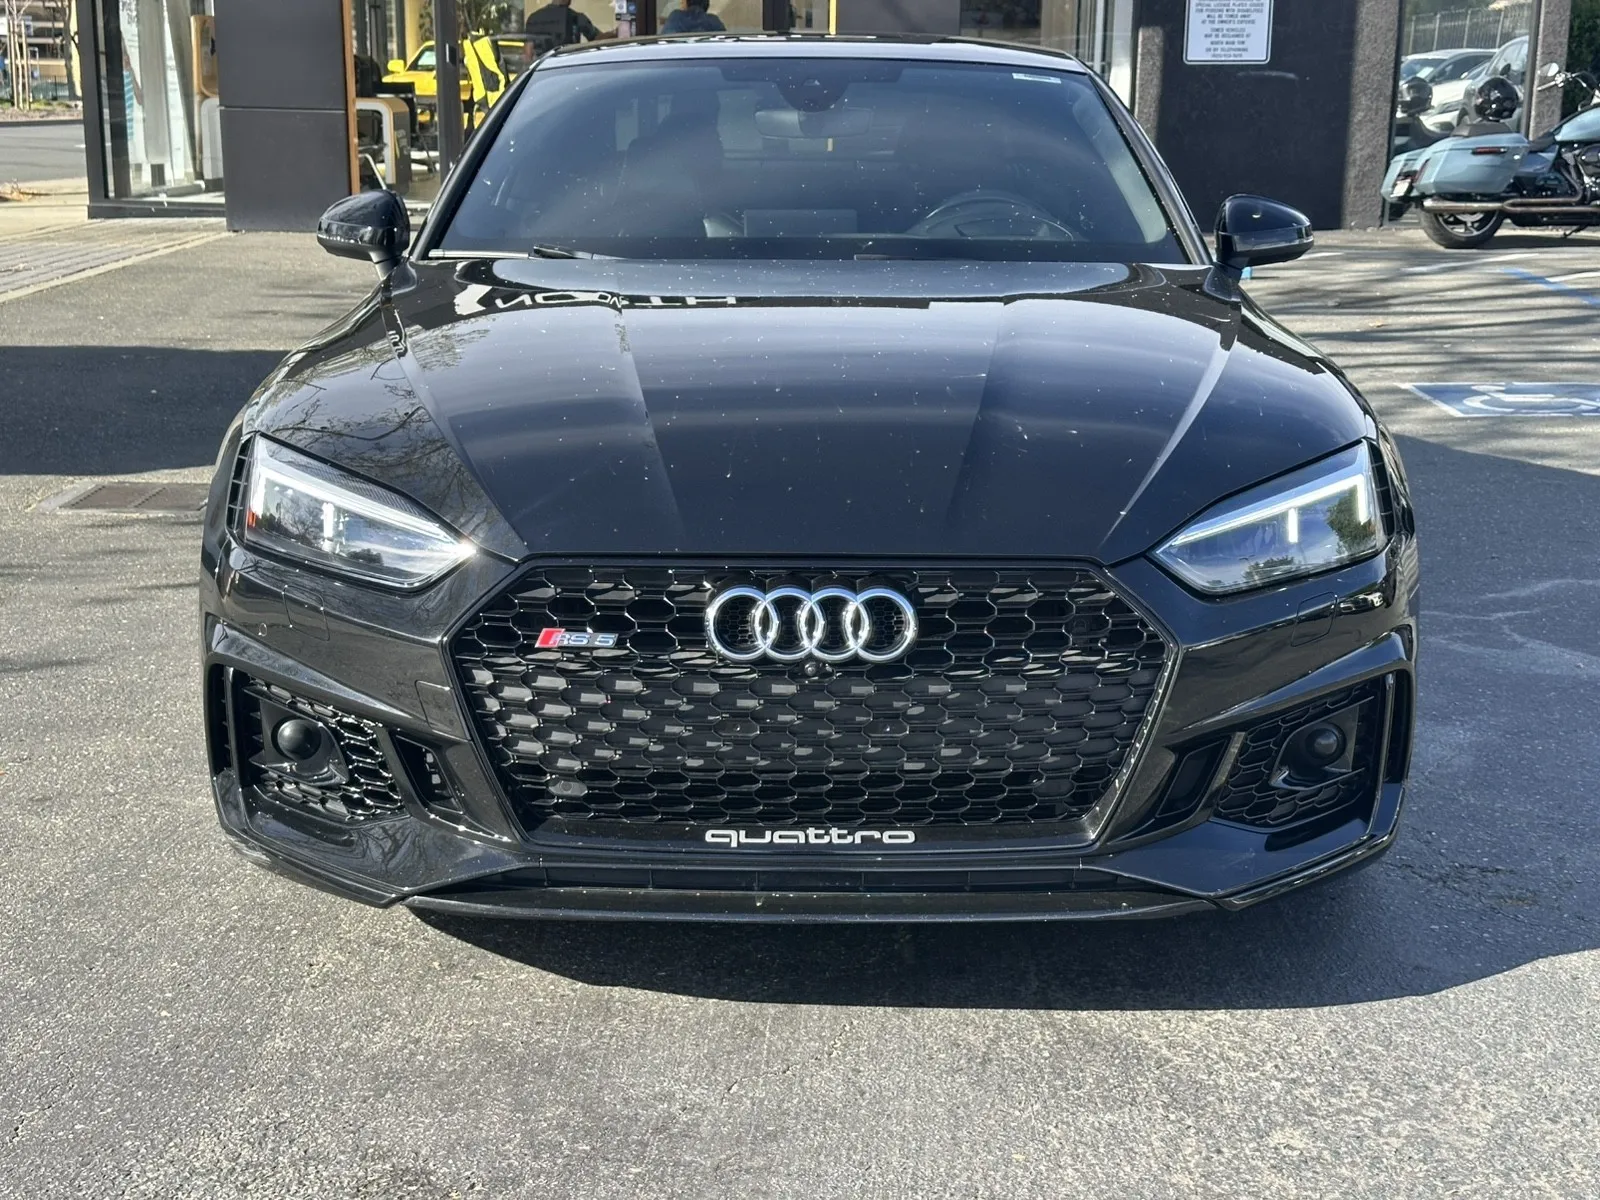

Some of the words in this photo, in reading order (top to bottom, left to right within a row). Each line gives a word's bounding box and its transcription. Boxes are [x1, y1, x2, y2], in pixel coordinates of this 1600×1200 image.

[548, 633, 590, 645] RS
[594, 634, 615, 646] 5
[705, 827, 916, 848] quattro
